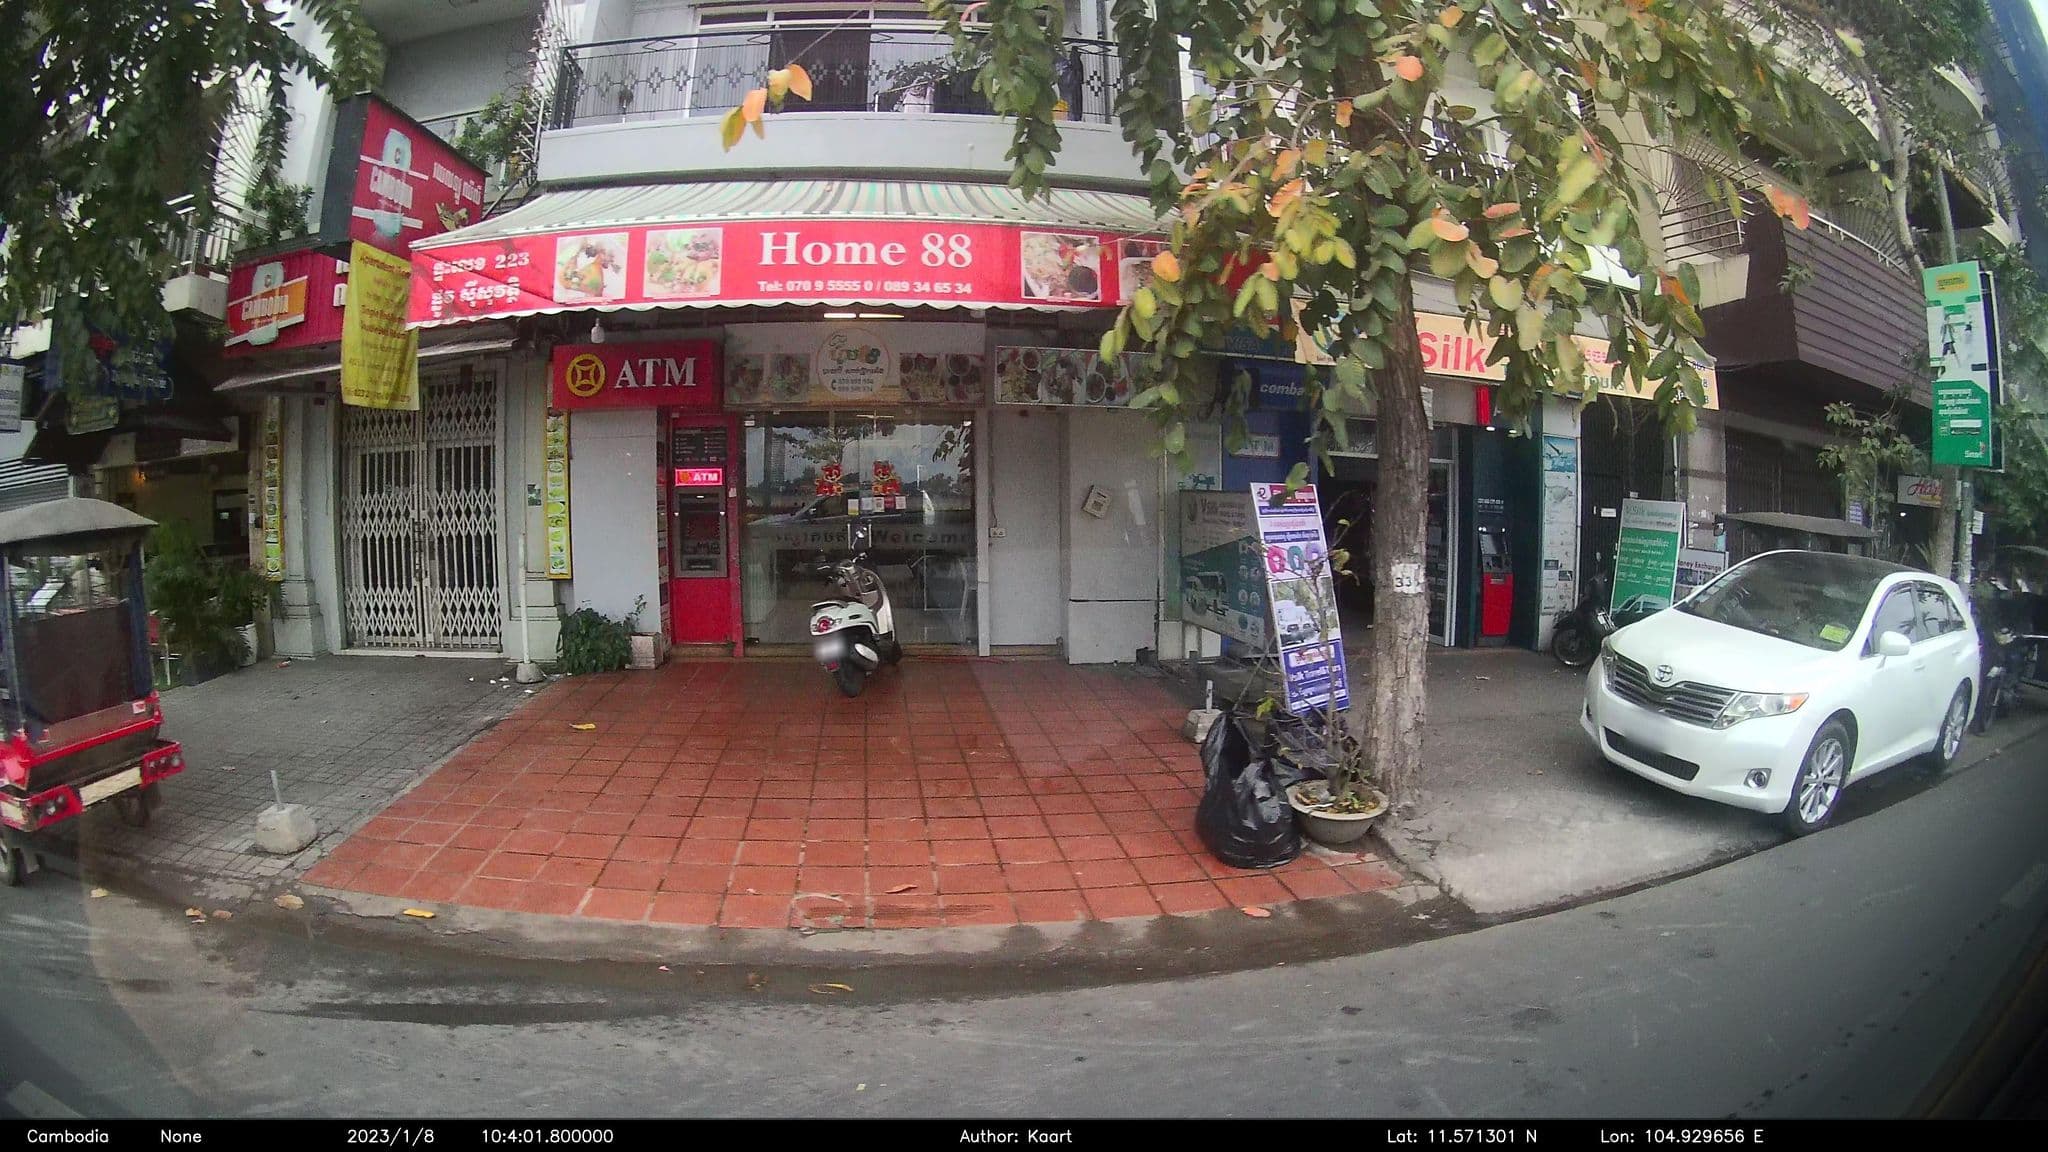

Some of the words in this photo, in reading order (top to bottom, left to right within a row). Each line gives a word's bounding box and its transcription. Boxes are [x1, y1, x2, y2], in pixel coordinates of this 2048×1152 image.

[758, 231, 906, 266] Home
[921, 232, 973, 268] 88
[494, 252, 530, 269] 223
[757, 280, 783, 292] Tel:
[814, 281, 824, 292] 9
[827, 280, 861, 292] 5555
[864, 281, 874, 292] 0
[883, 281, 910, 293] 089
[912, 282, 931, 293] 34
[933, 282, 952, 294] 65
[954, 283, 973, 294] 34
[1418, 331, 1487, 373] Silk
[613, 357, 697, 389] ATM
[693, 472, 719, 482] ATM
[1677, 559, 1694, 569] oney
